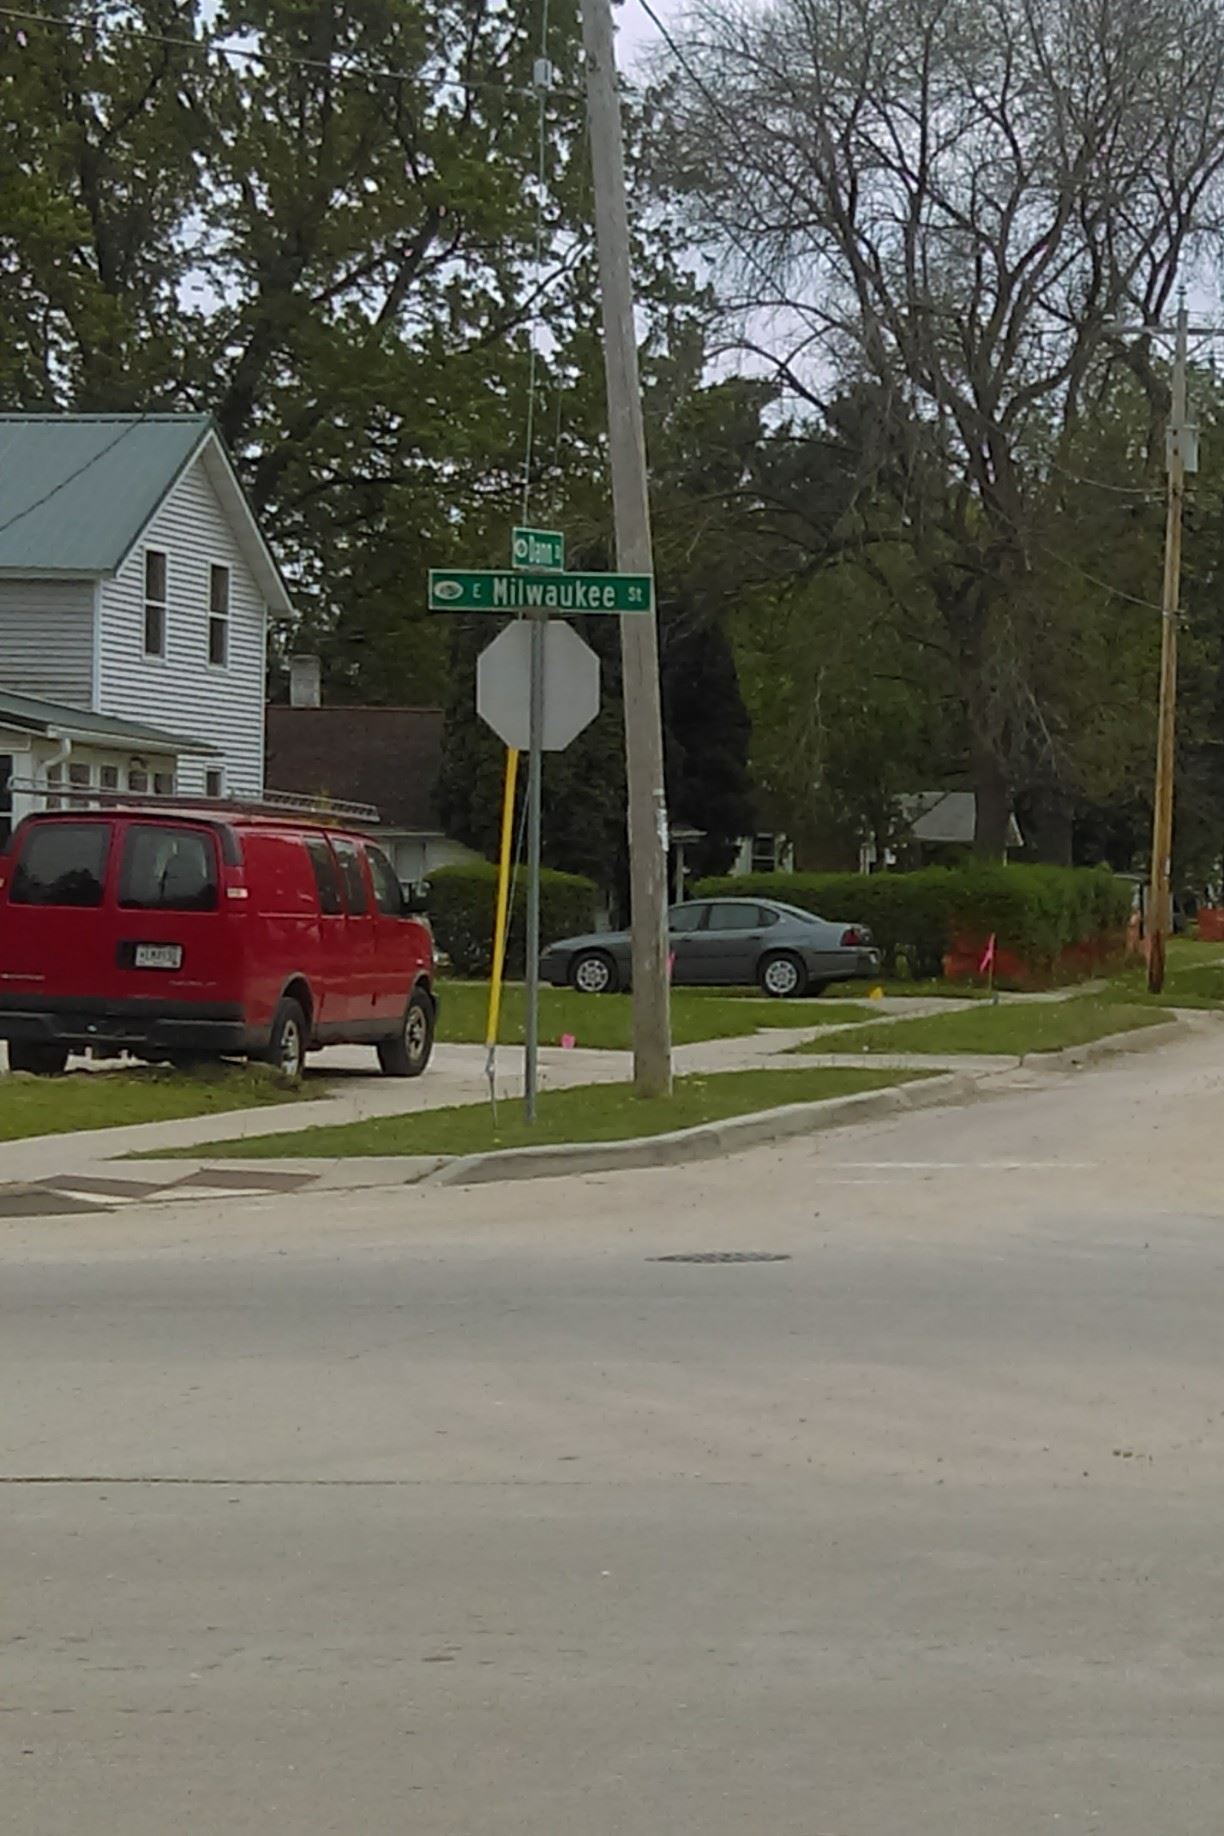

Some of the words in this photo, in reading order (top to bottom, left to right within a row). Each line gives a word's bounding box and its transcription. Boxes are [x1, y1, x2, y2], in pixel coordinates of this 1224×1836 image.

[473, 583, 481, 598] E
[493, 578, 615, 608] Milwaukee
[628, 586, 642, 602] St
